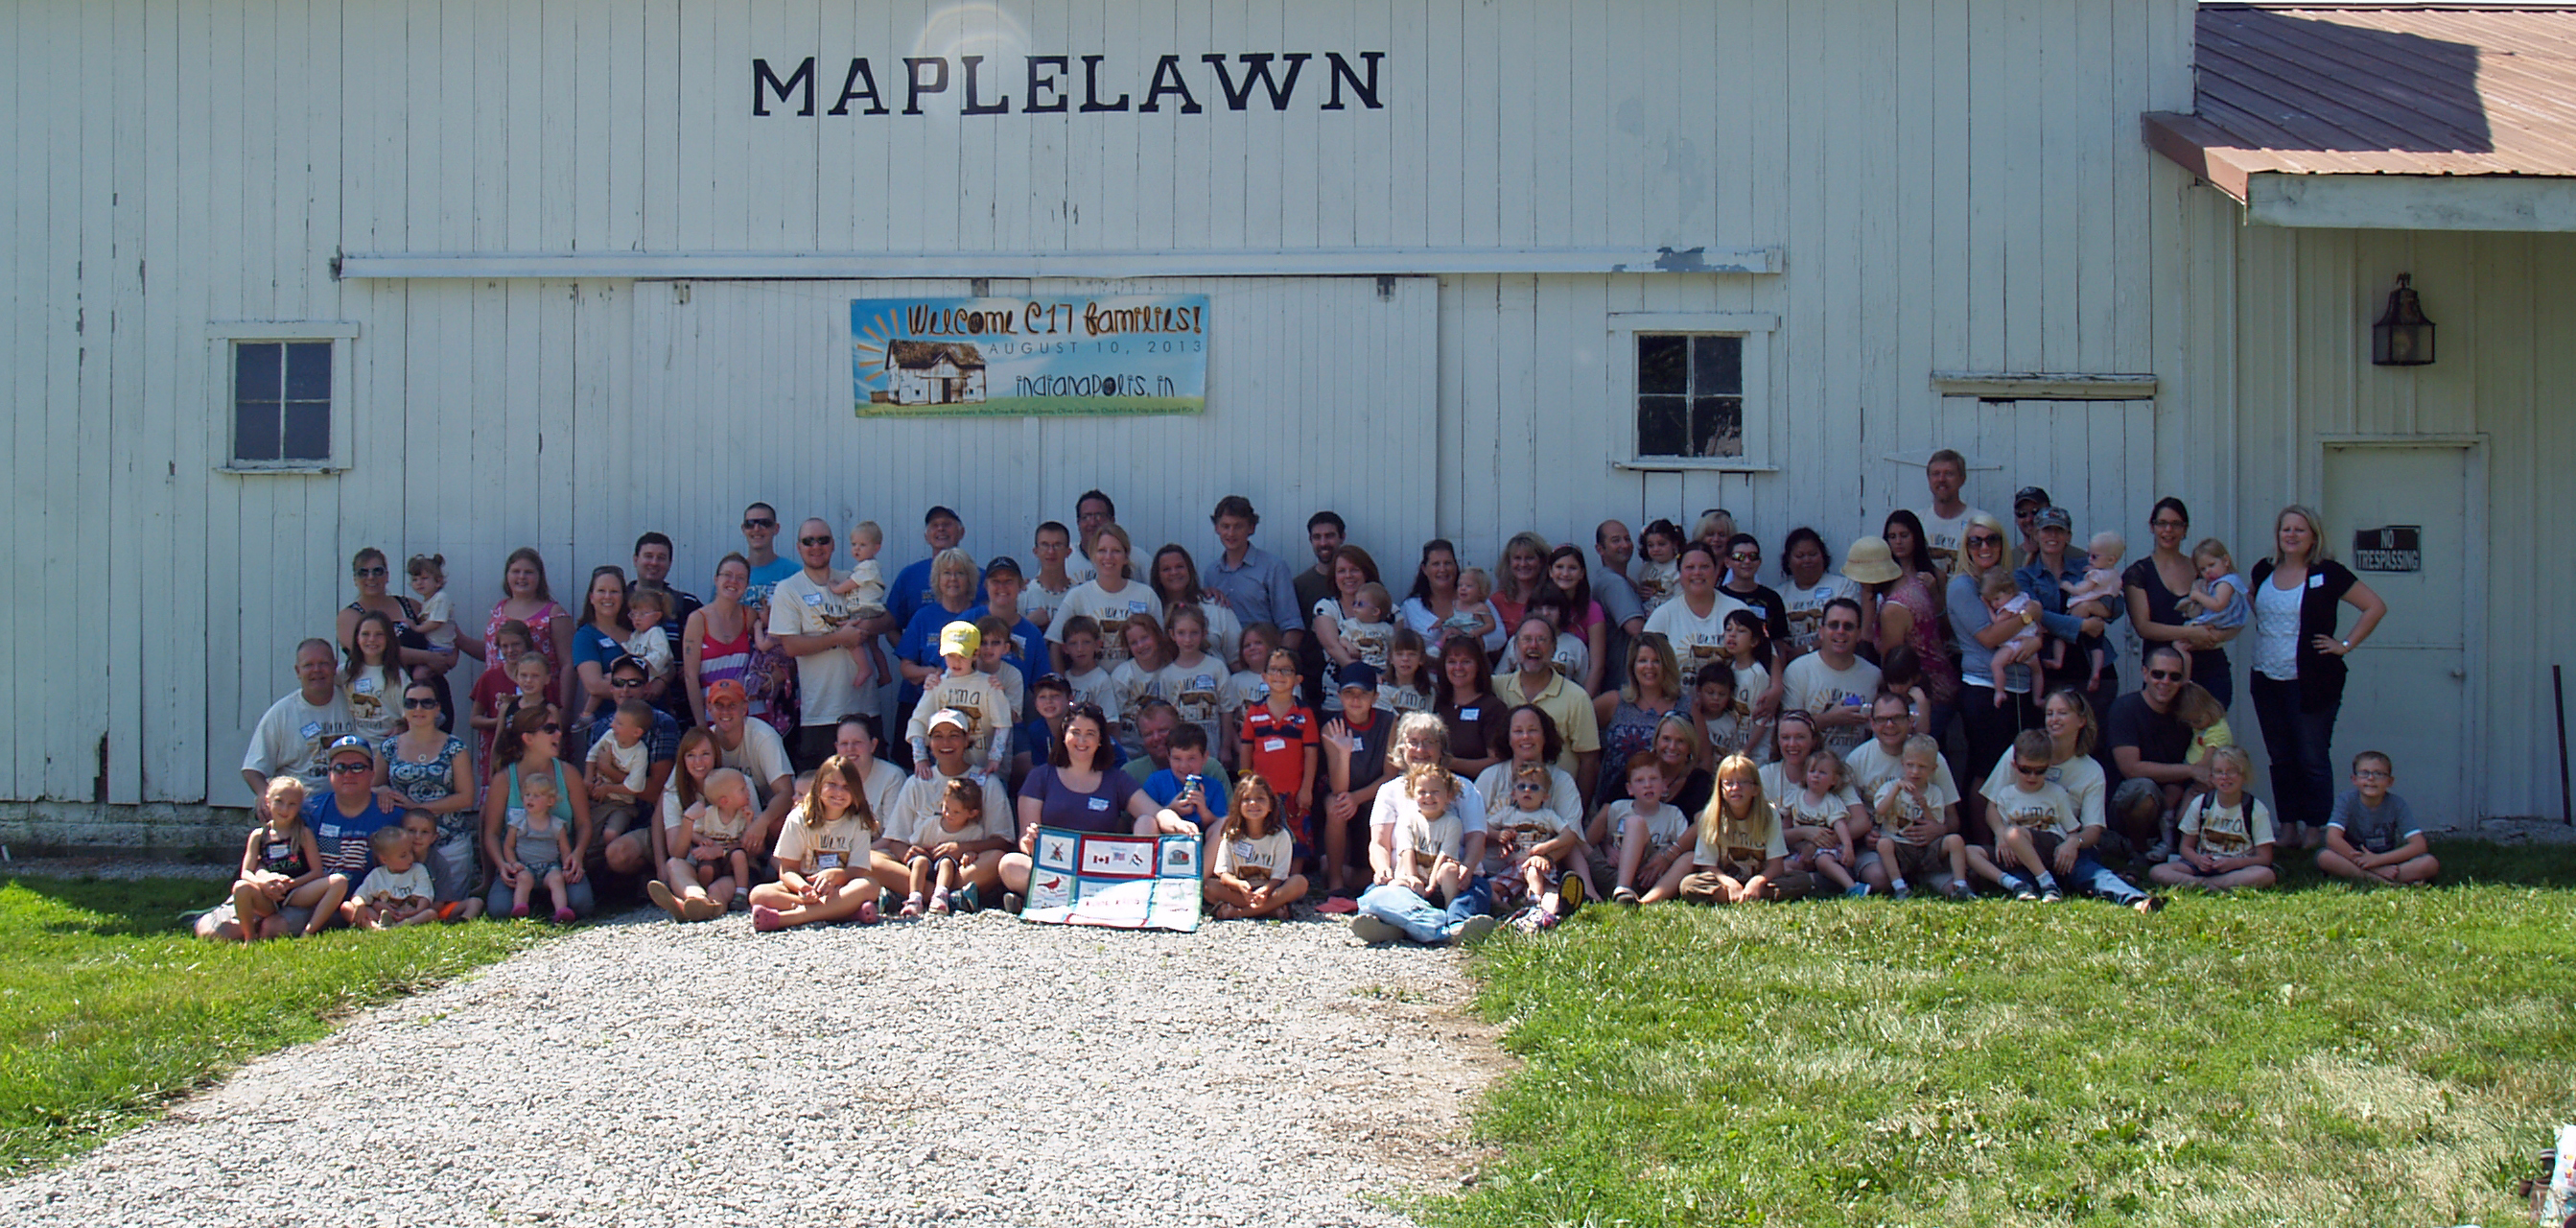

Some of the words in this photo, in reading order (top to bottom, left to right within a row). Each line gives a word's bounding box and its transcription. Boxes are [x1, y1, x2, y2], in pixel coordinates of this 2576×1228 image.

[753, 51, 1386, 116] MAPLELAWN
[906, 303, 1019, 336] Welcome
[1023, 302, 1072, 335] C17
[1083, 300, 1203, 337] families!
[989, 342, 1079, 355] AUGUST
[1096, 342, 1131, 356] 10,
[1148, 341, 1202, 353] 2013
[1157, 374, 1175, 397] in
[2380, 530, 2395, 550] NO
[2356, 549, 2418, 570] TRESPASSING
[970, 691, 980, 706] a
